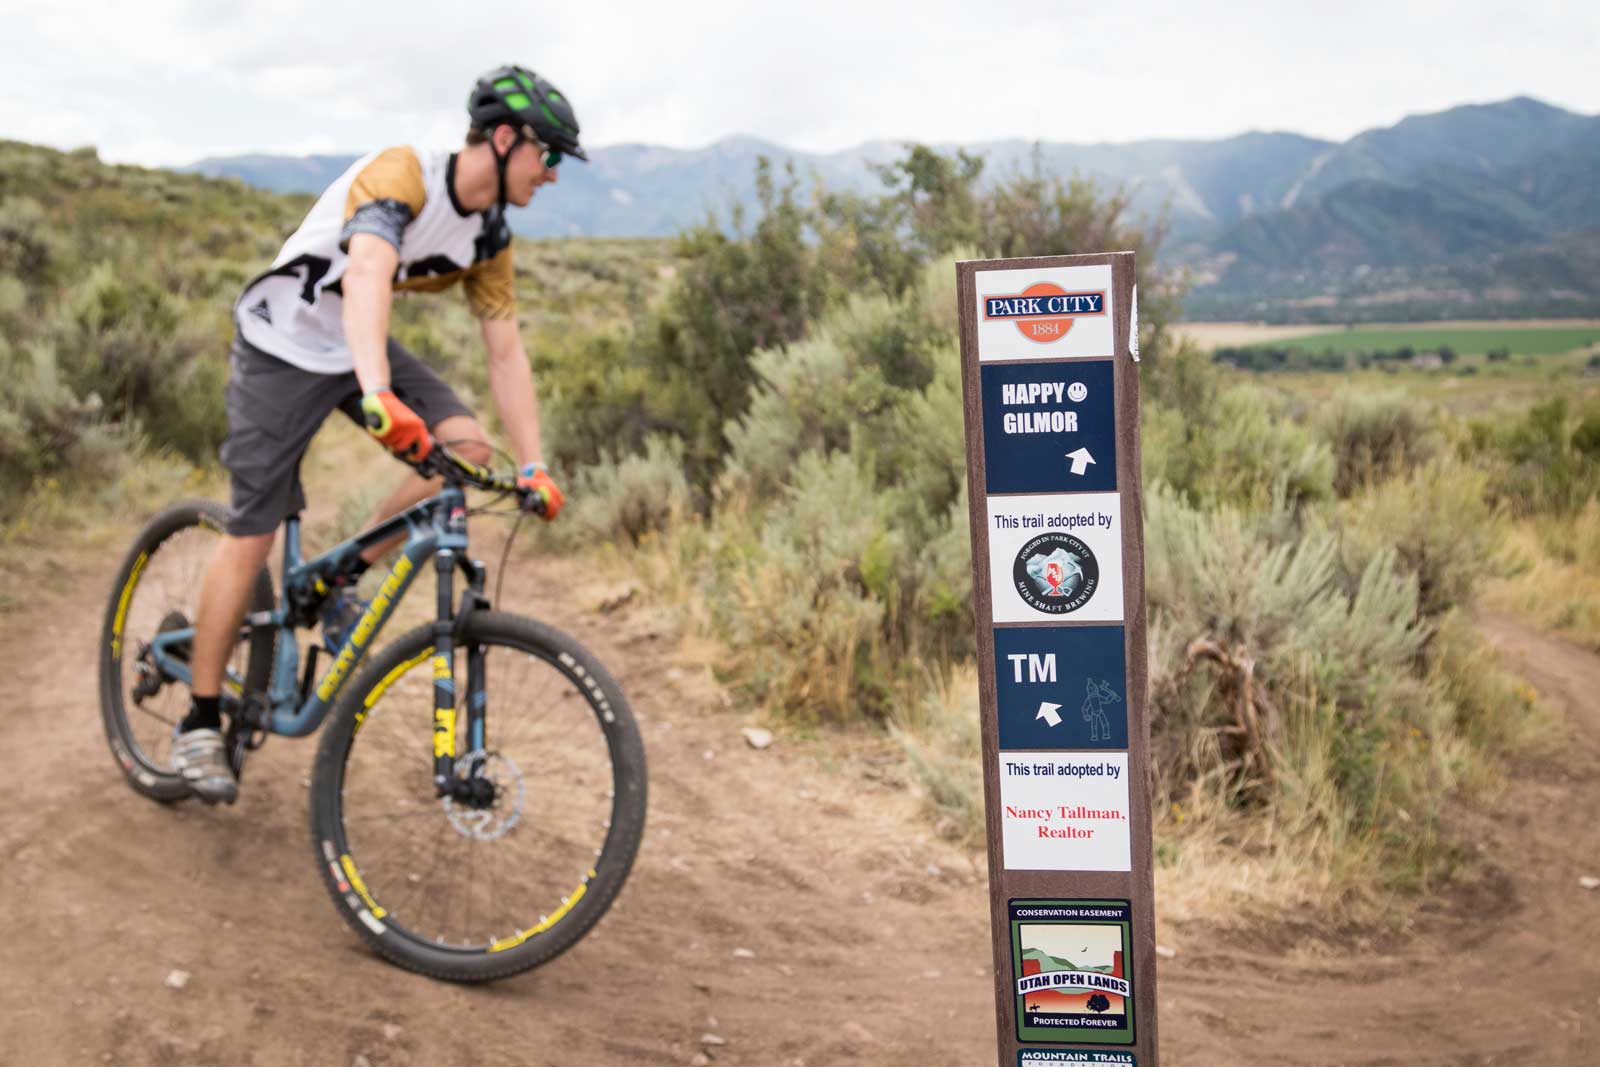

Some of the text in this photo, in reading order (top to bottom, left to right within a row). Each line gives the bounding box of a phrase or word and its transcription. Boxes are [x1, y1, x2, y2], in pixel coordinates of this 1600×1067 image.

[989, 295, 1100, 316] PARK CITY
[1031, 323, 1060, 335] 1884
[1002, 382, 1065, 405] HAPPY
[1003, 411, 1078, 434] GILMOR
[994, 512, 1113, 530] This trail adopted by
[1020, 535, 1090, 560] FORGED IN PARK CITY UT
[1018, 579, 1095, 611] MINE SHAFT BREWING
[1007, 653, 1057, 683] TM
[1006, 763, 1121, 779] This trail adopted by
[1006, 806, 1126, 822] Nancy Tallman,
[1038, 825, 1094, 839] Realtor
[1016, 909, 1123, 917] CONSERVATION EASEMENT
[1019, 973, 1128, 993] UTAH OPEN LANDS
[1022, 1052, 1132, 1063] MOUNTAIN TRAILS
